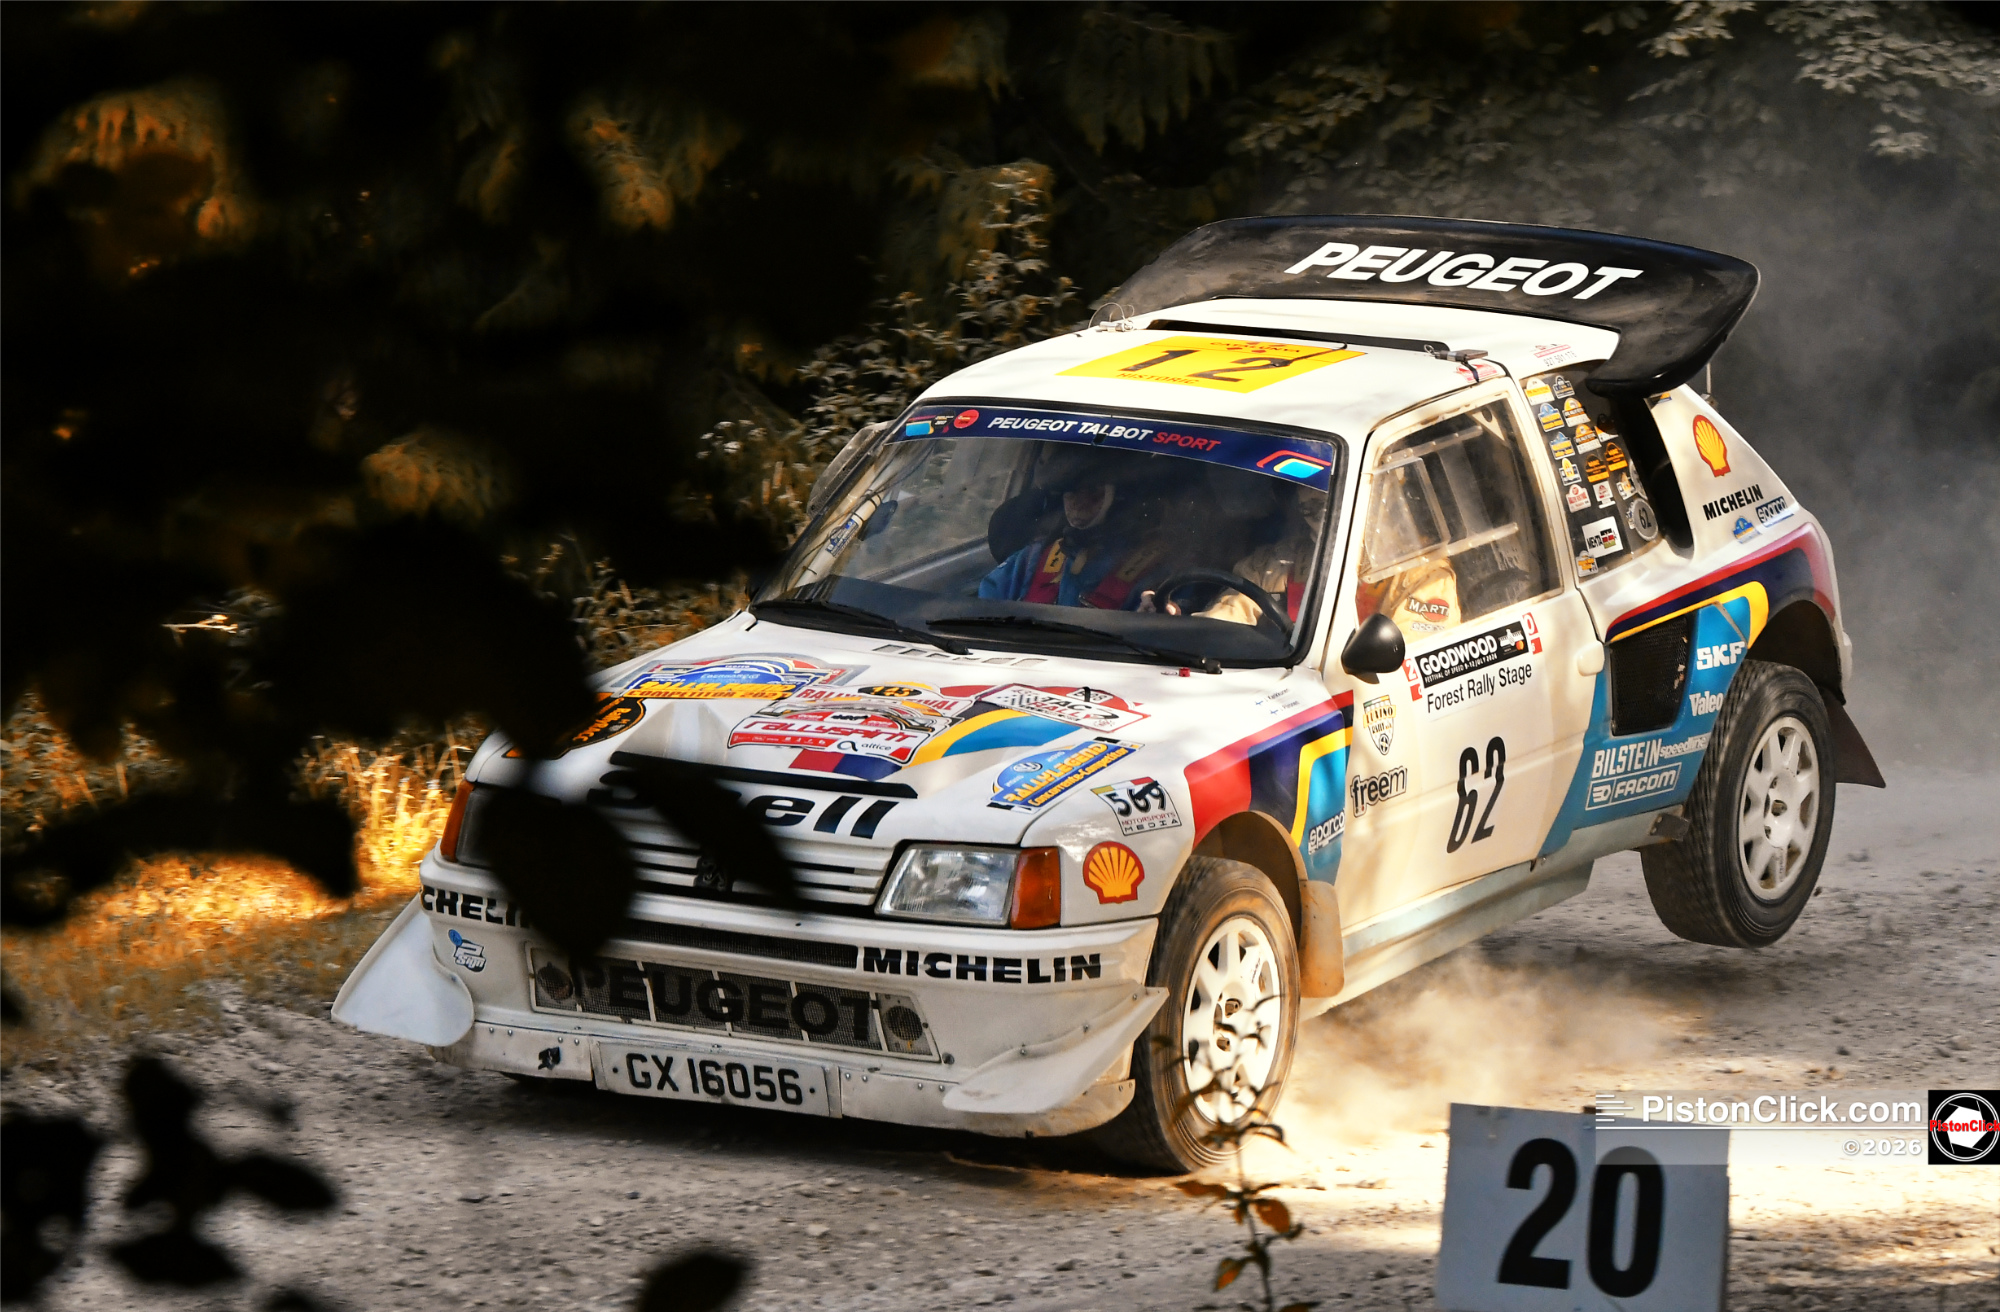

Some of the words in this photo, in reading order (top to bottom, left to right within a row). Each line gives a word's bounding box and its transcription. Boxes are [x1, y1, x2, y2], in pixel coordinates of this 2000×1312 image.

[1284, 242, 1645, 300] PEUGEOT
[1118, 349, 1291, 382] 12
[987, 416, 1077, 433] PEUGEOT
[1077, 421, 1153, 442] TALBOT
[1152, 431, 1222, 452] SPORT
[1703, 484, 1764, 520] MICHELIN
[1419, 635, 1498, 676] GOODWOOD
[1696, 641, 1746, 670] SKF
[1424, 671, 1444, 683] FESTIVAL
[1444, 668, 1452, 676] OF
[1451, 665, 1464, 675] SPEED
[1427, 683, 1465, 713] Forest
[1467, 673, 1496, 699] Rally
[1498, 664, 1533, 687] Stage
[1043, 696, 1093, 711] TAC
[1689, 691, 1725, 717] Valeo
[861, 742, 892, 751] altice
[1592, 739, 1663, 779] BILSTEIN
[1002, 743, 1108, 802] RALLYLEGEND
[1352, 768, 1407, 813] freem
[1614, 769, 1677, 799] FACOM
[1104, 785, 1167, 817] 569
[1446, 736, 1506, 854] 62
[1121, 811, 1177, 827] MOTORSPORTS
[1124, 818, 1179, 833] MEDIA
[1309, 810, 1345, 849] sparco
[863, 947, 1102, 984] MICHELIN
[626, 1053, 679, 1092] GX
[687, 1058, 803, 1105] 16056
[1496, 1137, 1666, 1299] 20
